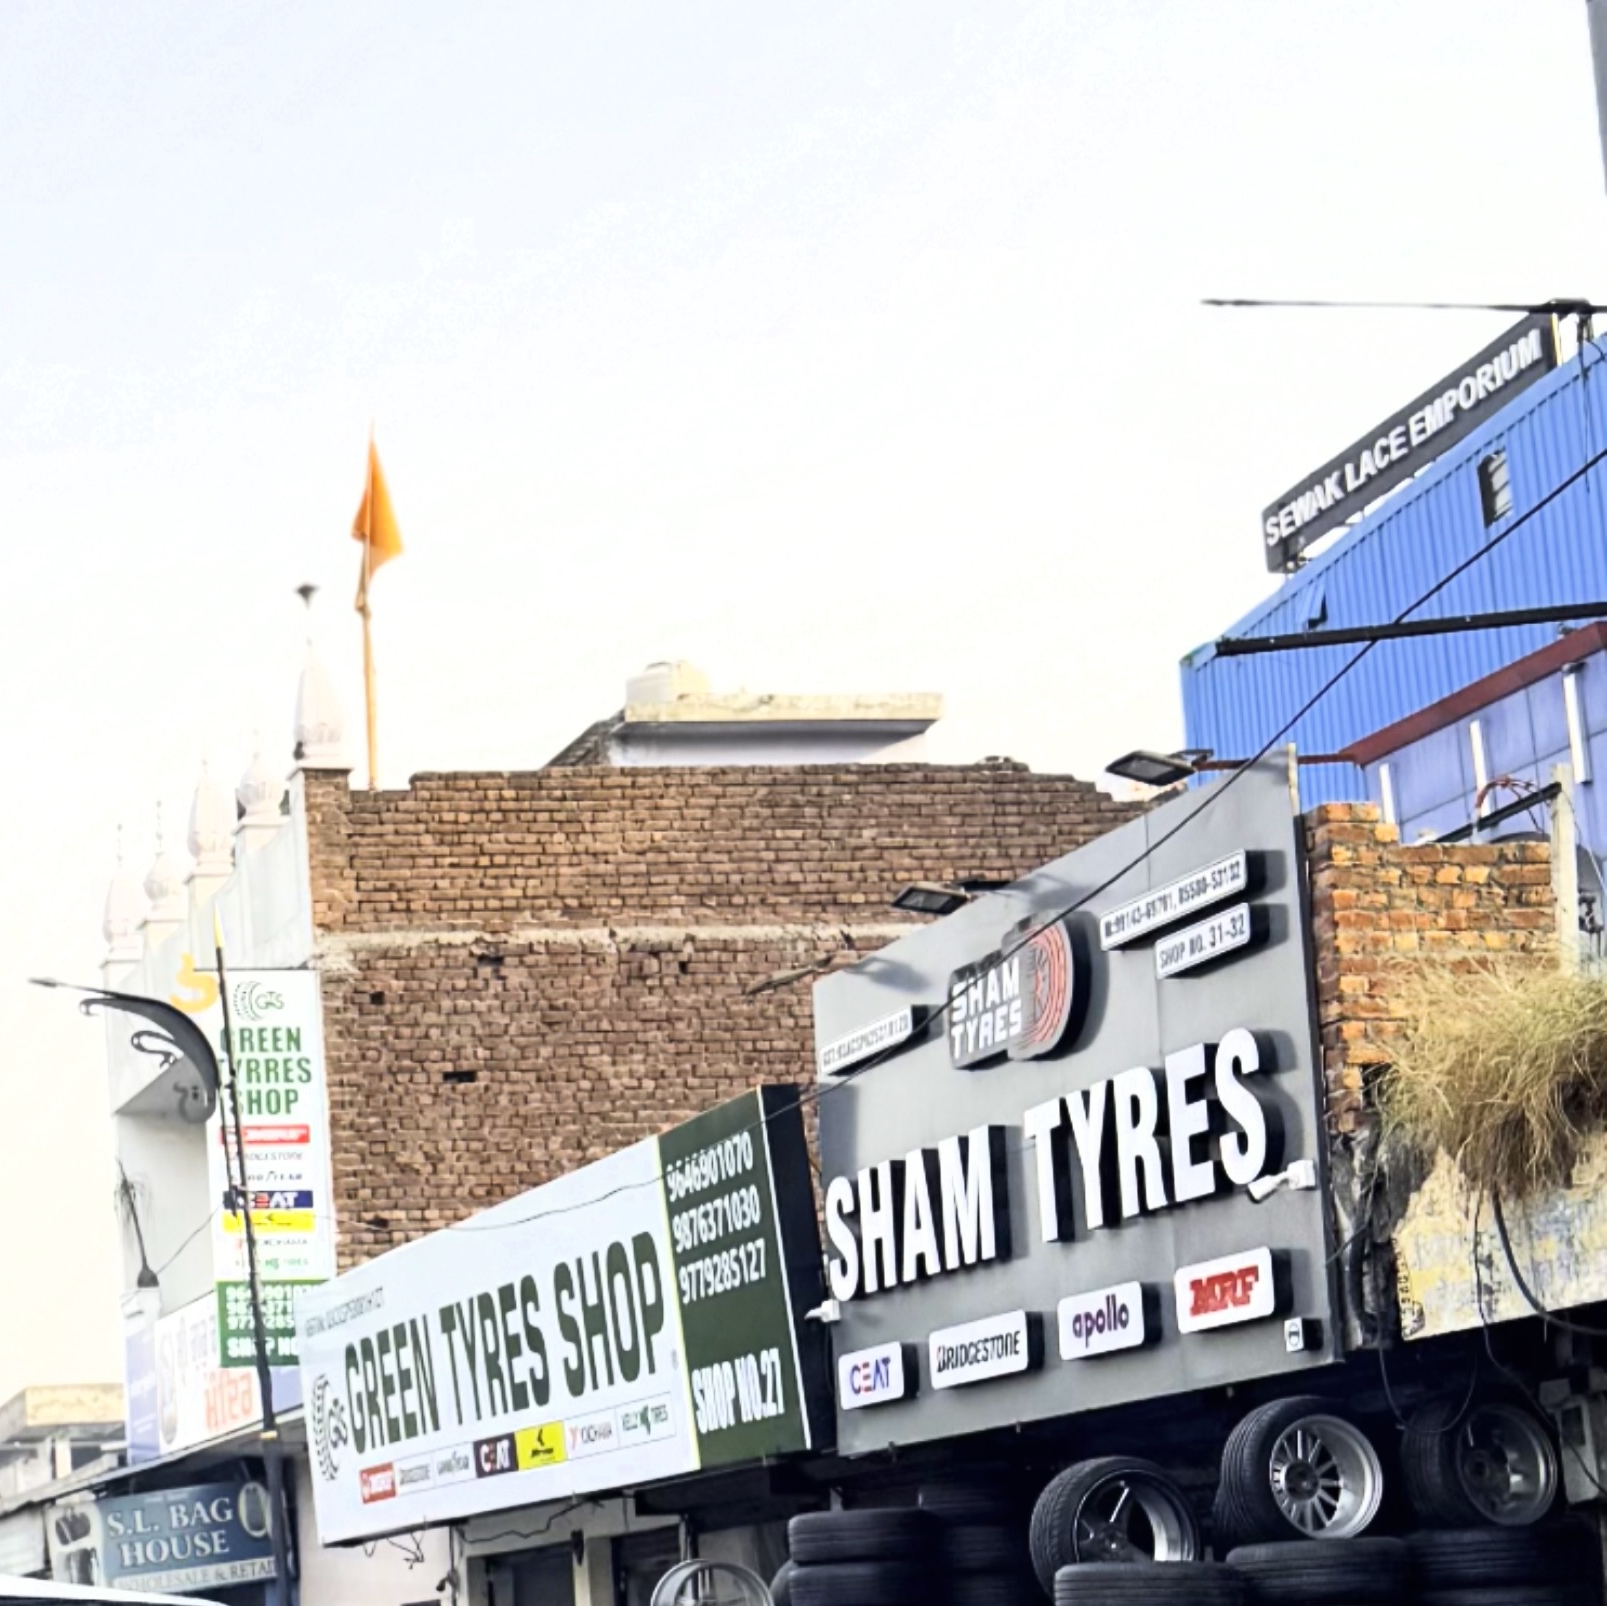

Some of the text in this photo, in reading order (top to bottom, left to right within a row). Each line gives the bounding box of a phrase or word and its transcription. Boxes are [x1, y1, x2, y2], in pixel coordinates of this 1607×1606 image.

[1265, 329, 1543, 546] SEWAK LACE EMPORIUM
[1160, 942, 1186, 969] SHOP
[1209, 913, 1246, 948] 31-32
[952, 956, 1020, 1023] SHAM
[951, 999, 1022, 1060] TYRES
[219, 1057, 312, 1084] RRES
[231, 1089, 299, 1116] HOP
[826, 1027, 1267, 1301] SHAM TYRES
[679, 1238, 767, 1304] 9779285127
[228, 1336, 276, 1358] SHP
[346, 1313, 440, 1455] GREEN
[439, 1274, 552, 1426] TYRES
[553, 1231, 666, 1398] SHOP
[850, 1265, 1259, 1393] CEAT BRIDGESTONE apollo MRF
[692, 1361, 736, 1434] SHOP
[107, 1498, 233, 1538] S.L. BAG
[120, 1530, 230, 1567] HOUSE
